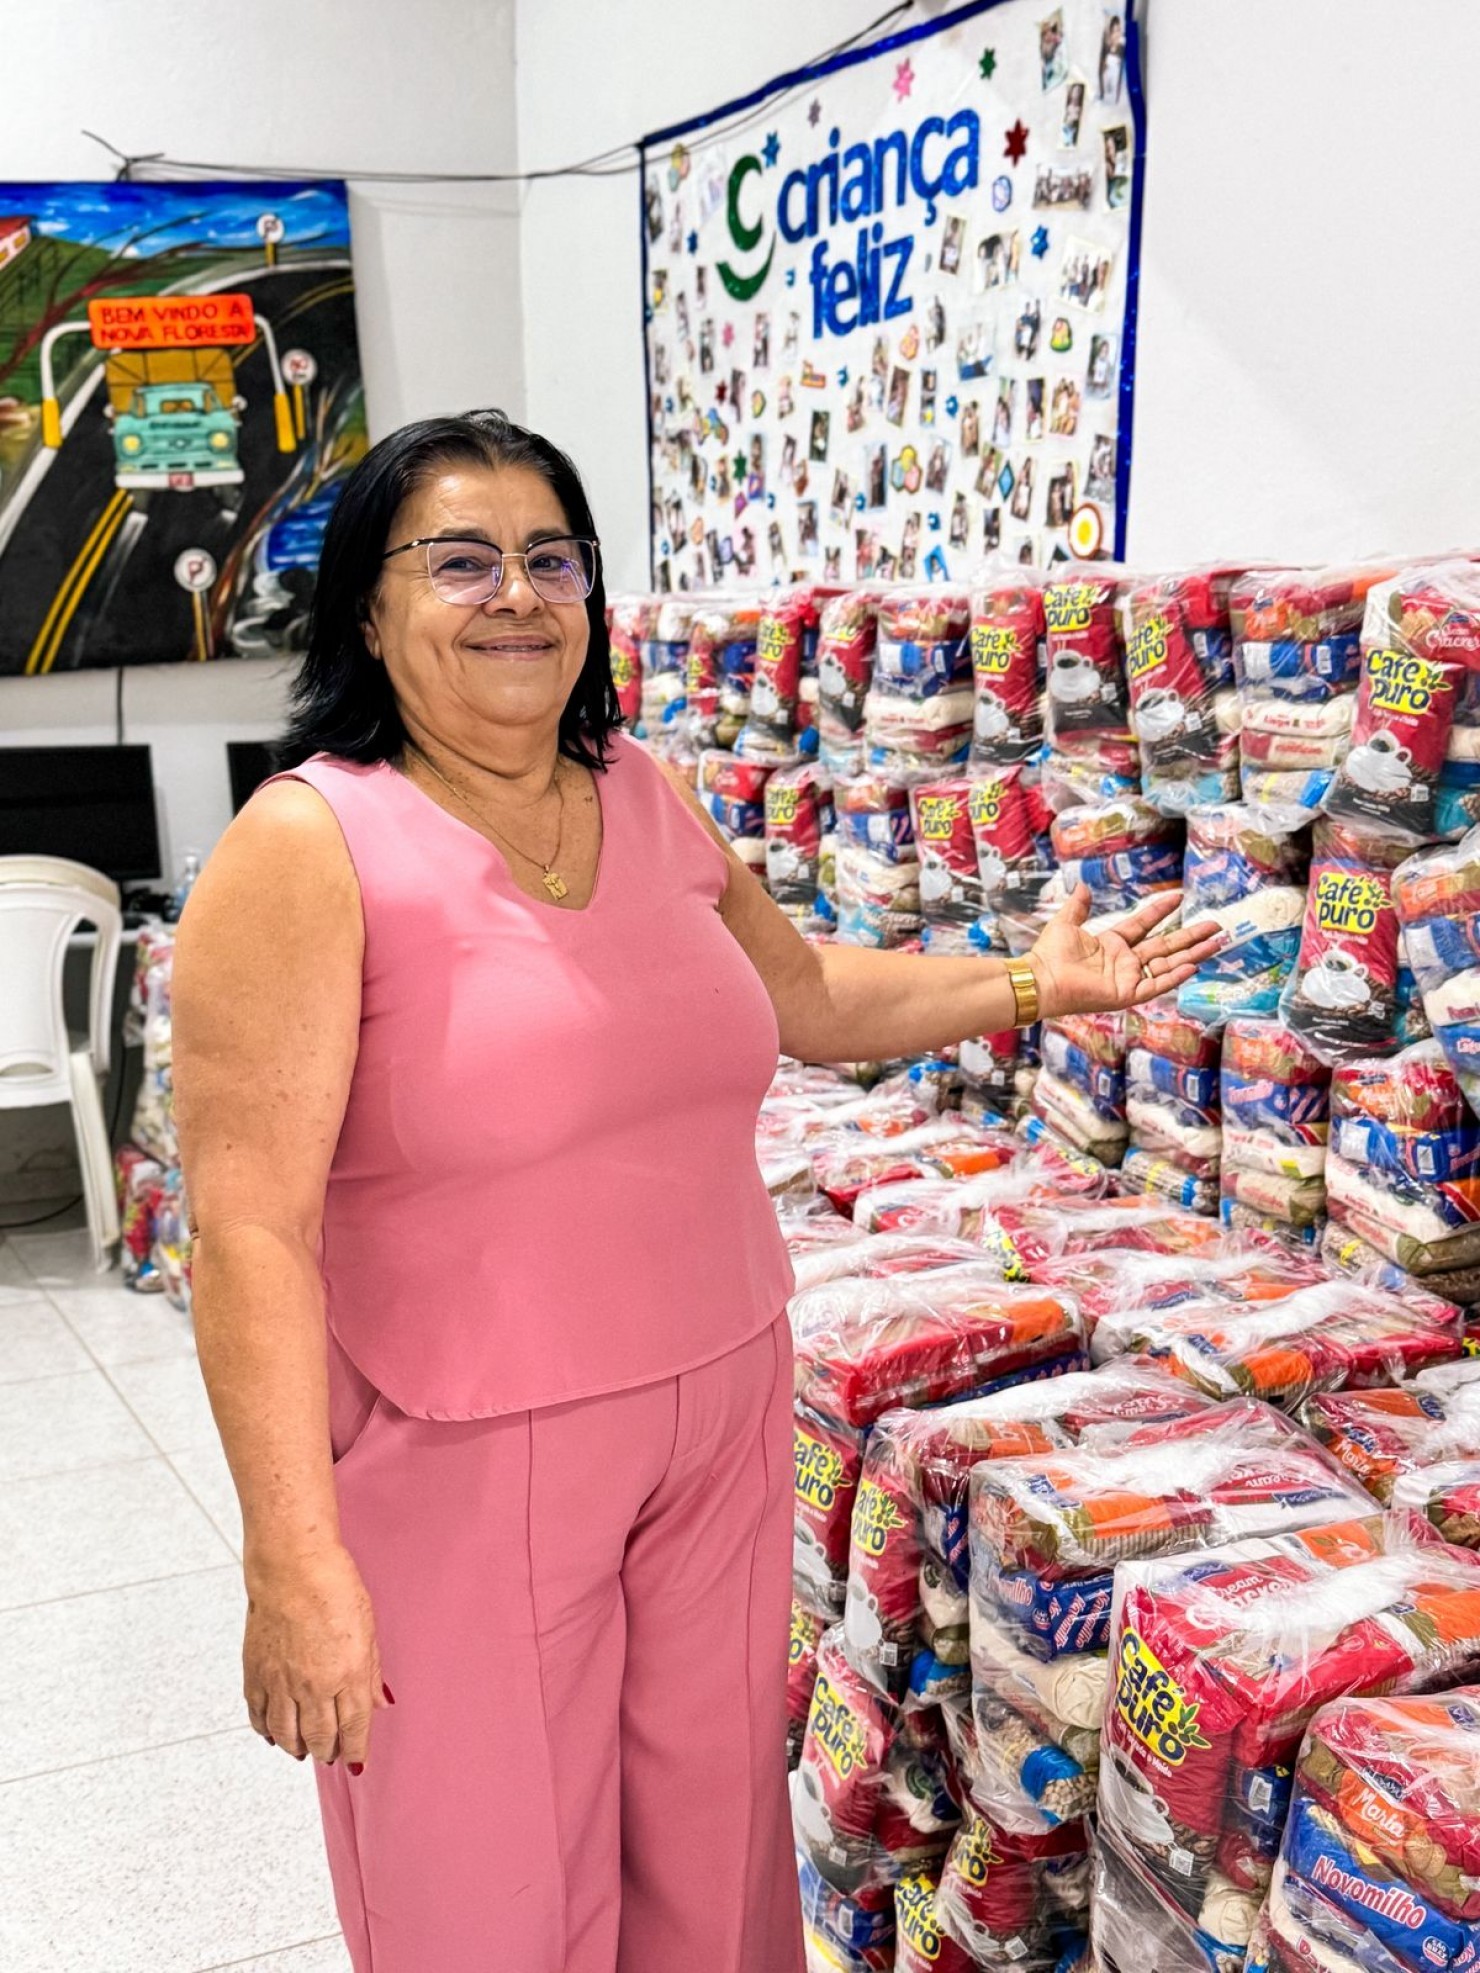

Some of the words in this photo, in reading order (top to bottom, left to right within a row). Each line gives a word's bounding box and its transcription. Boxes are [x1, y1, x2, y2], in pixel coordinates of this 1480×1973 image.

[777, 108, 980, 244] criança
[809, 221, 915, 339] feliz
[101, 327, 153, 342] NOVA
[162, 323, 249, 341] FLORESTA
[102, 306, 145, 324] BEM
[152, 303, 218, 320] VINDO
[230, 301, 244, 317] A
[1369, 679, 1431, 710] puro
[1316, 876, 1365, 905] Café
[1318, 902, 1375, 930] puro
[794, 1467, 835, 1507] uro
[1121, 1632, 1185, 1722] Café
[815, 1676, 857, 1742] Café
[1116, 1674, 1185, 1761] puro
[811, 1708, 853, 1775] puro
[1351, 1787, 1405, 1838] Maria
[1311, 1854, 1427, 1930] Novomilho
